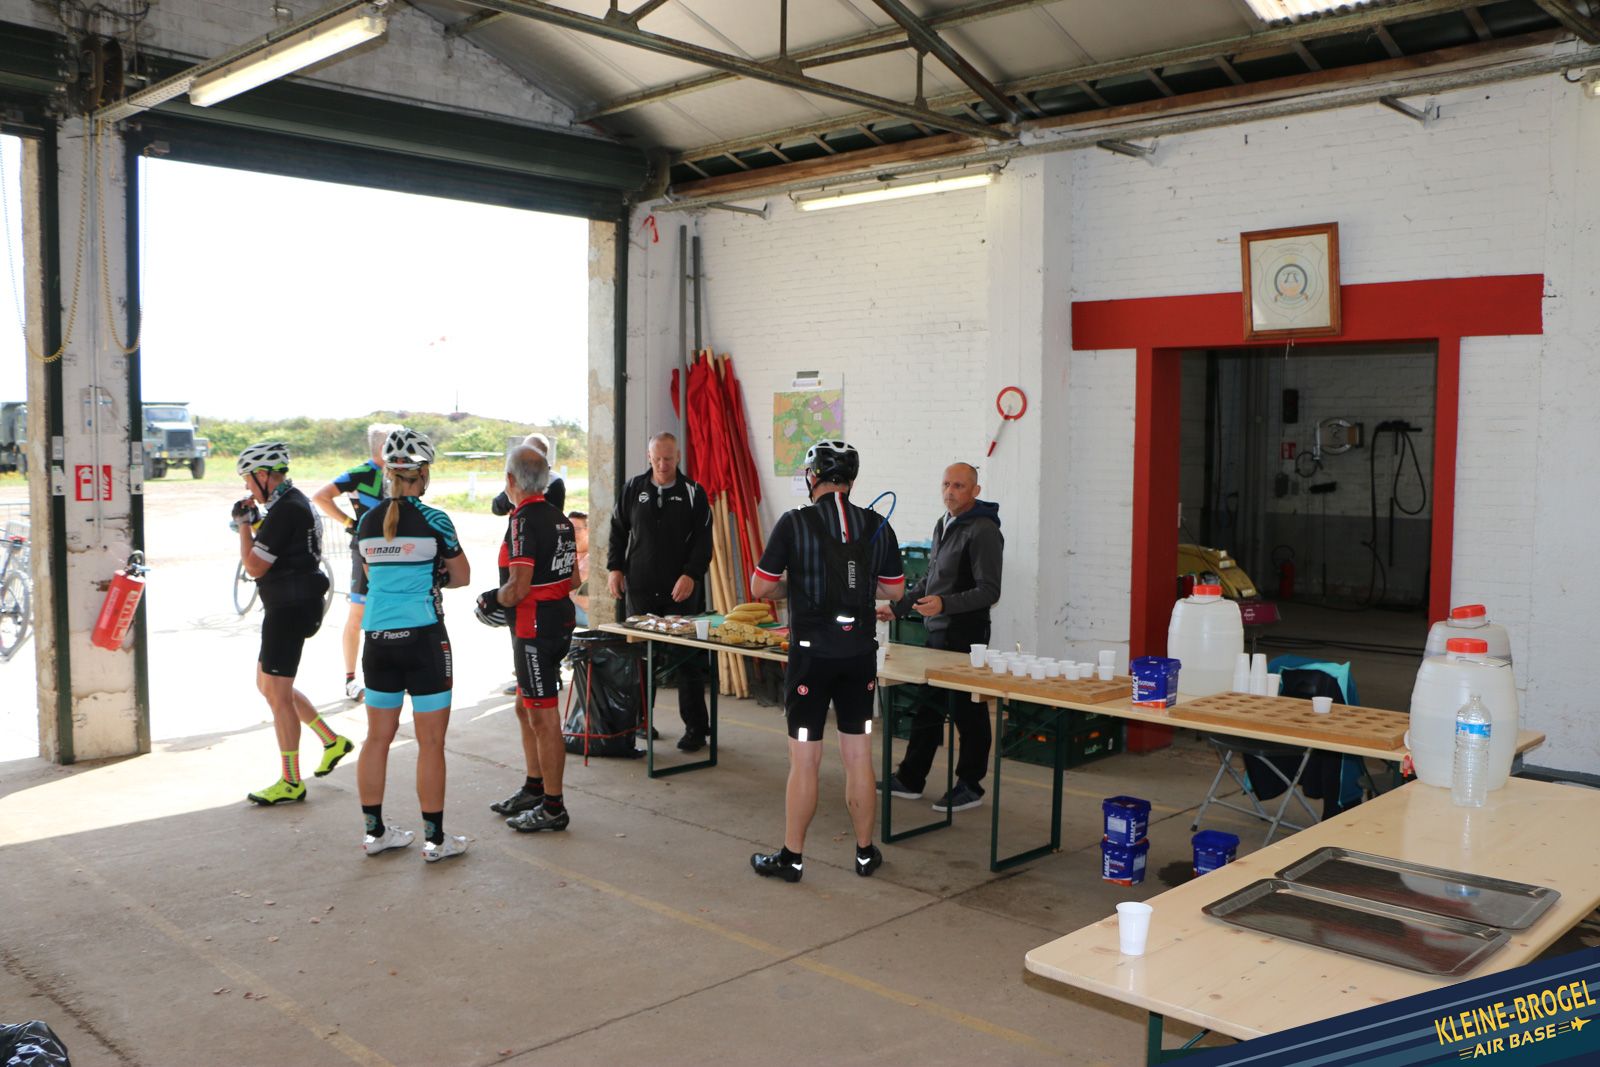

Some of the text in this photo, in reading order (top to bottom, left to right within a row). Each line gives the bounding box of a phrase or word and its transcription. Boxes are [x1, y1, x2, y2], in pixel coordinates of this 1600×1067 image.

[365, 545, 401, 554] tornado
[383, 630, 410, 640] Flexso
[531, 654, 544, 697] MEYNEN
